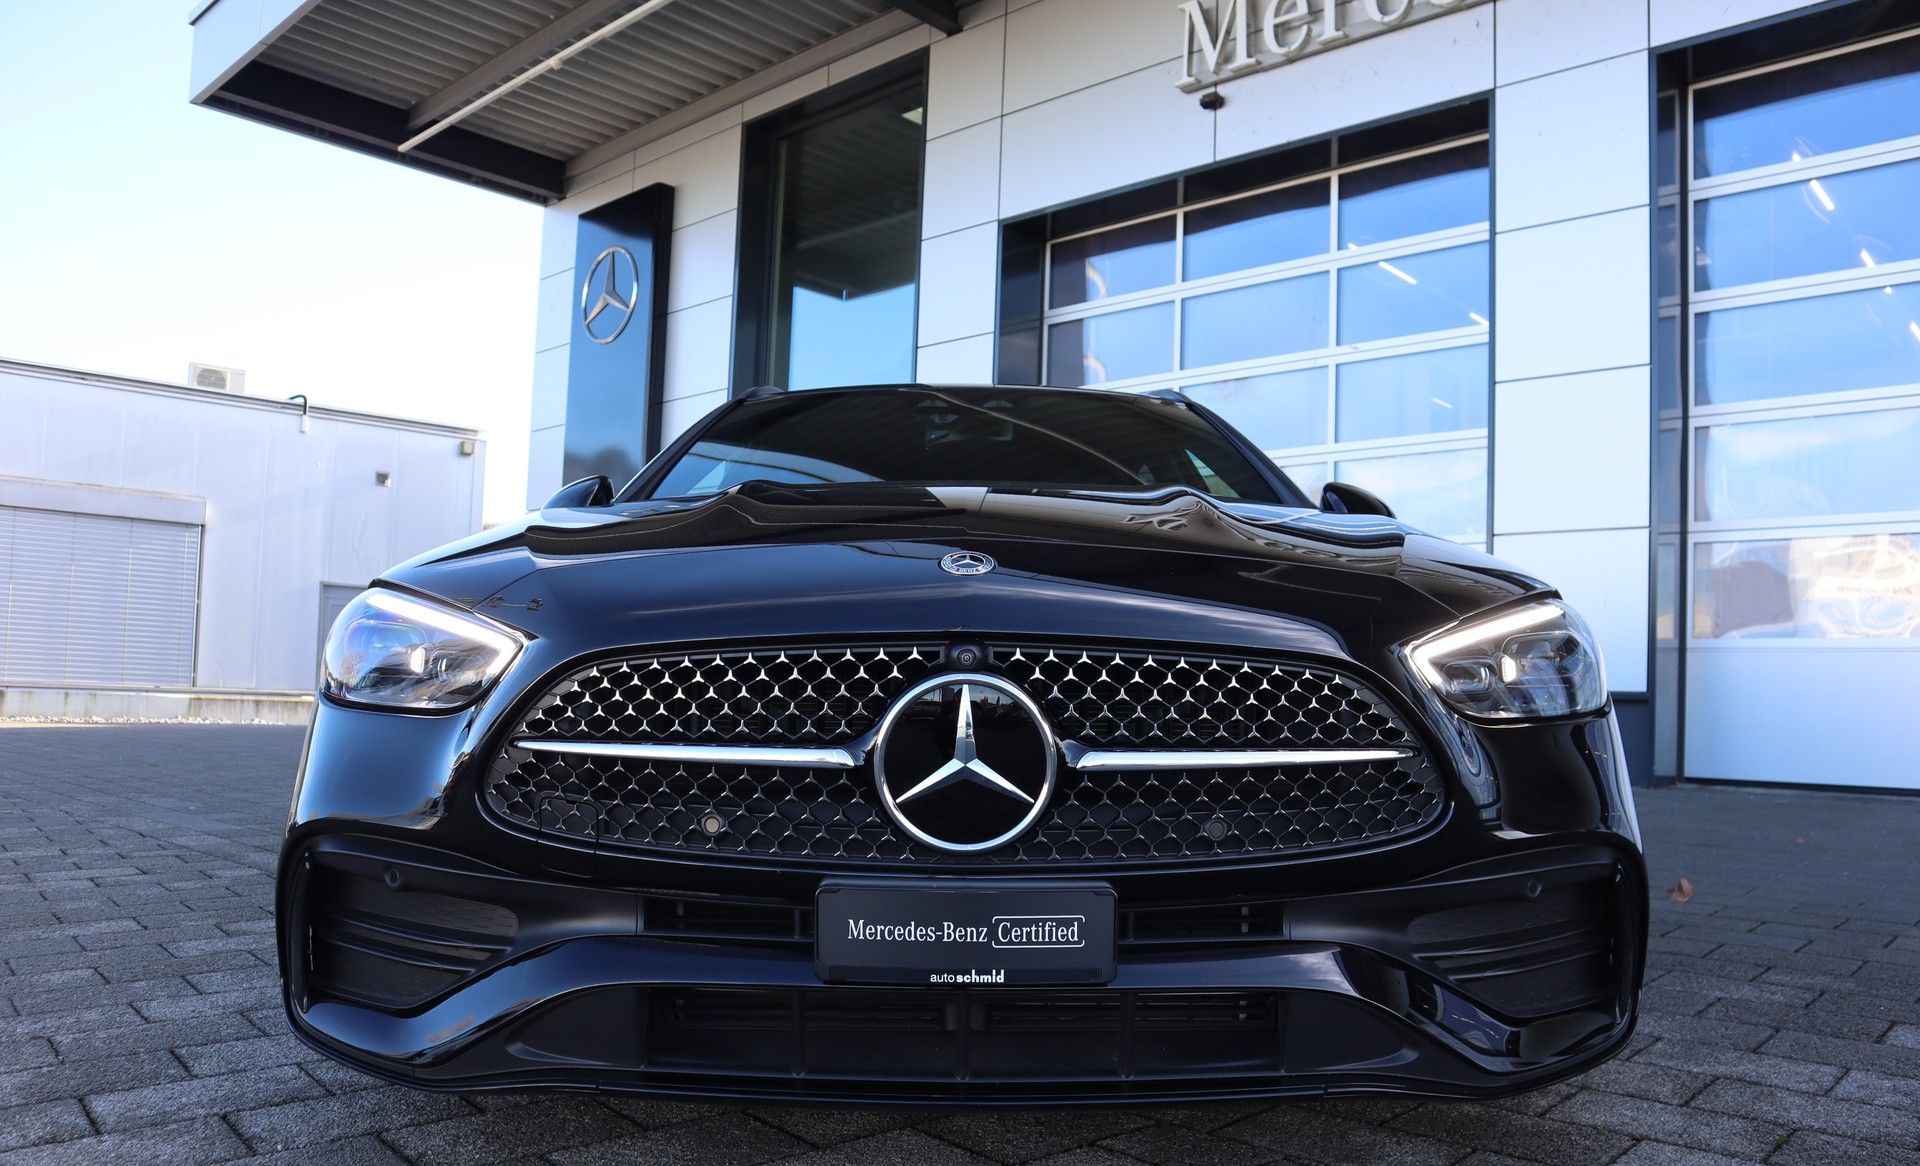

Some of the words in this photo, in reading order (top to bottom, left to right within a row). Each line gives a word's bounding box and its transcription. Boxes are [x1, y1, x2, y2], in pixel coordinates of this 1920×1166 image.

[1173, 0, 1458, 89] Mer
[847, 918, 988, 943] Mercedes-Benz
[997, 921, 1080, 943] Certified
